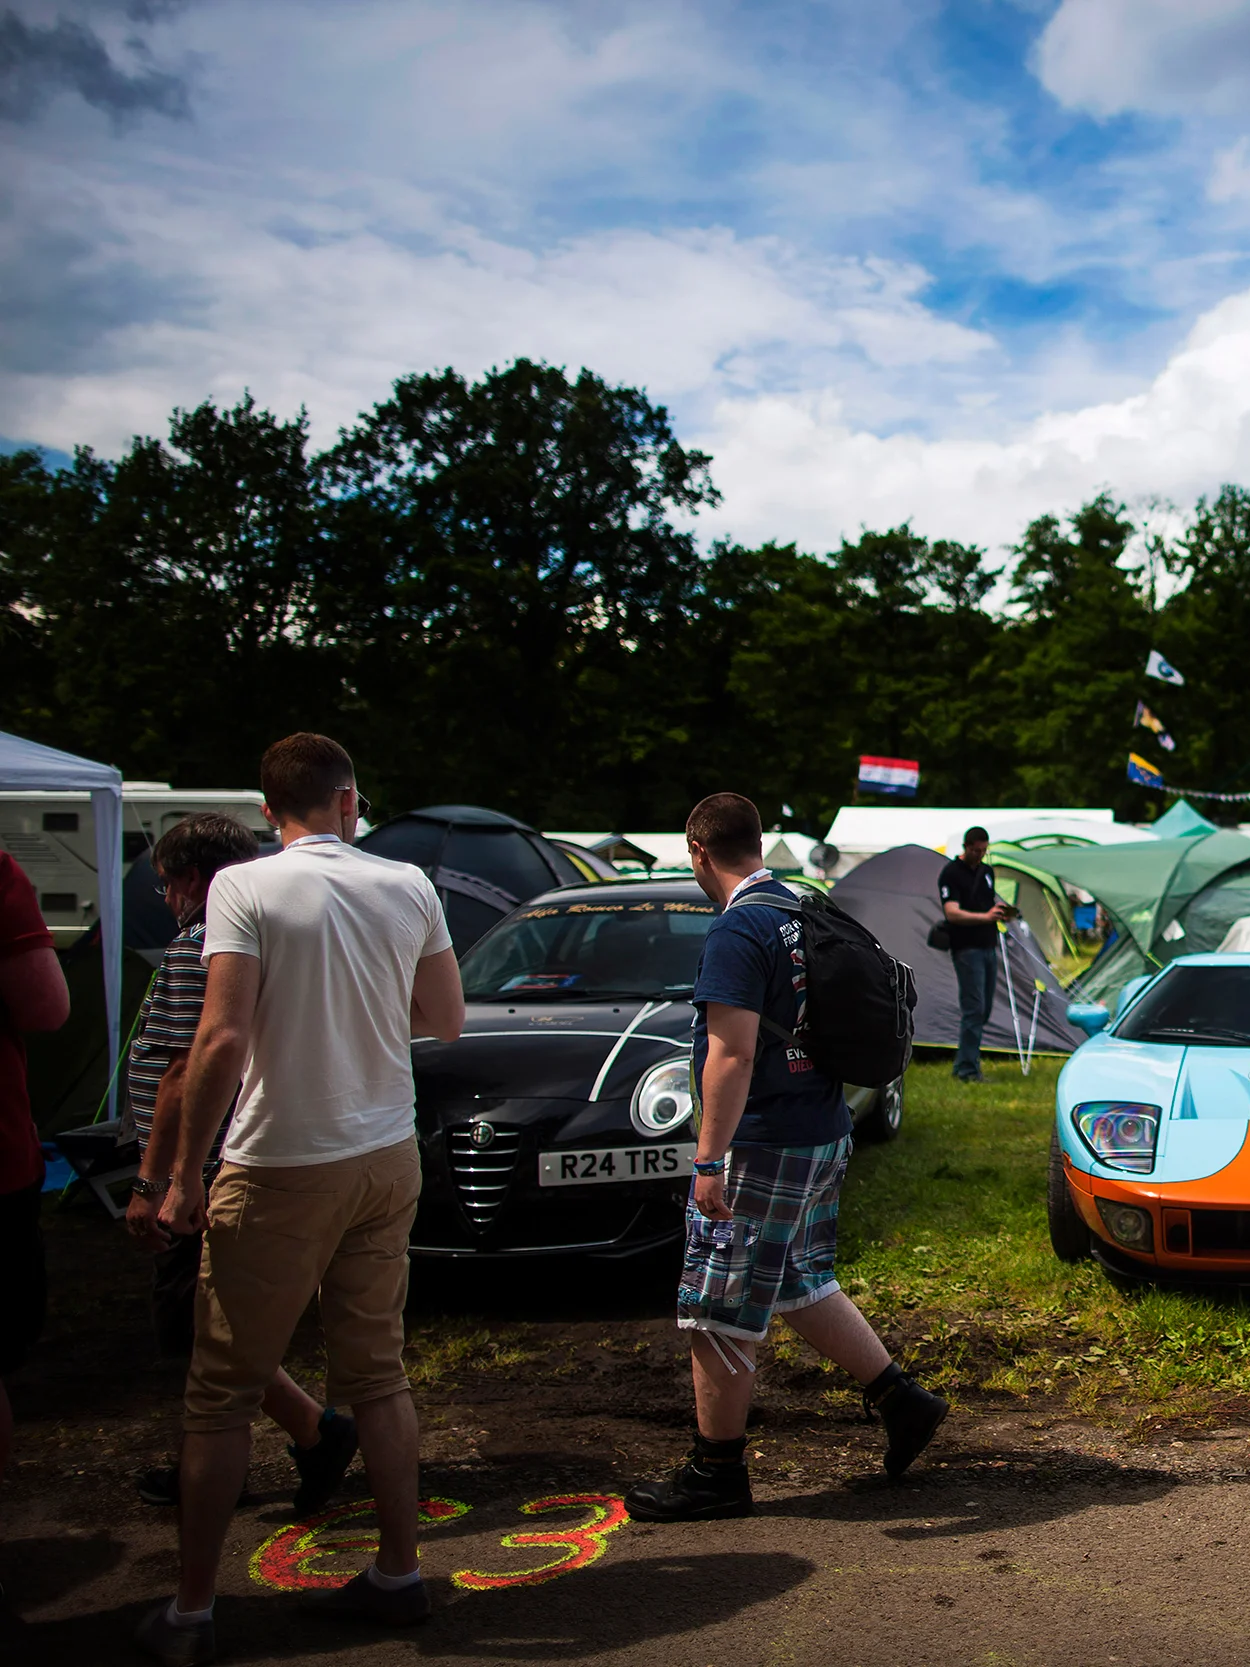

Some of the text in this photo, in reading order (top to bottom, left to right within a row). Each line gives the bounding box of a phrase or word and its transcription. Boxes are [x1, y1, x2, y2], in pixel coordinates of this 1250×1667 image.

[516, 901, 715, 920] Alfa Romeo Le Mans
[779, 922, 795, 937] OUR
[786, 1048, 807, 1060] EVE
[561, 1148, 678, 1179] R24 TRS
